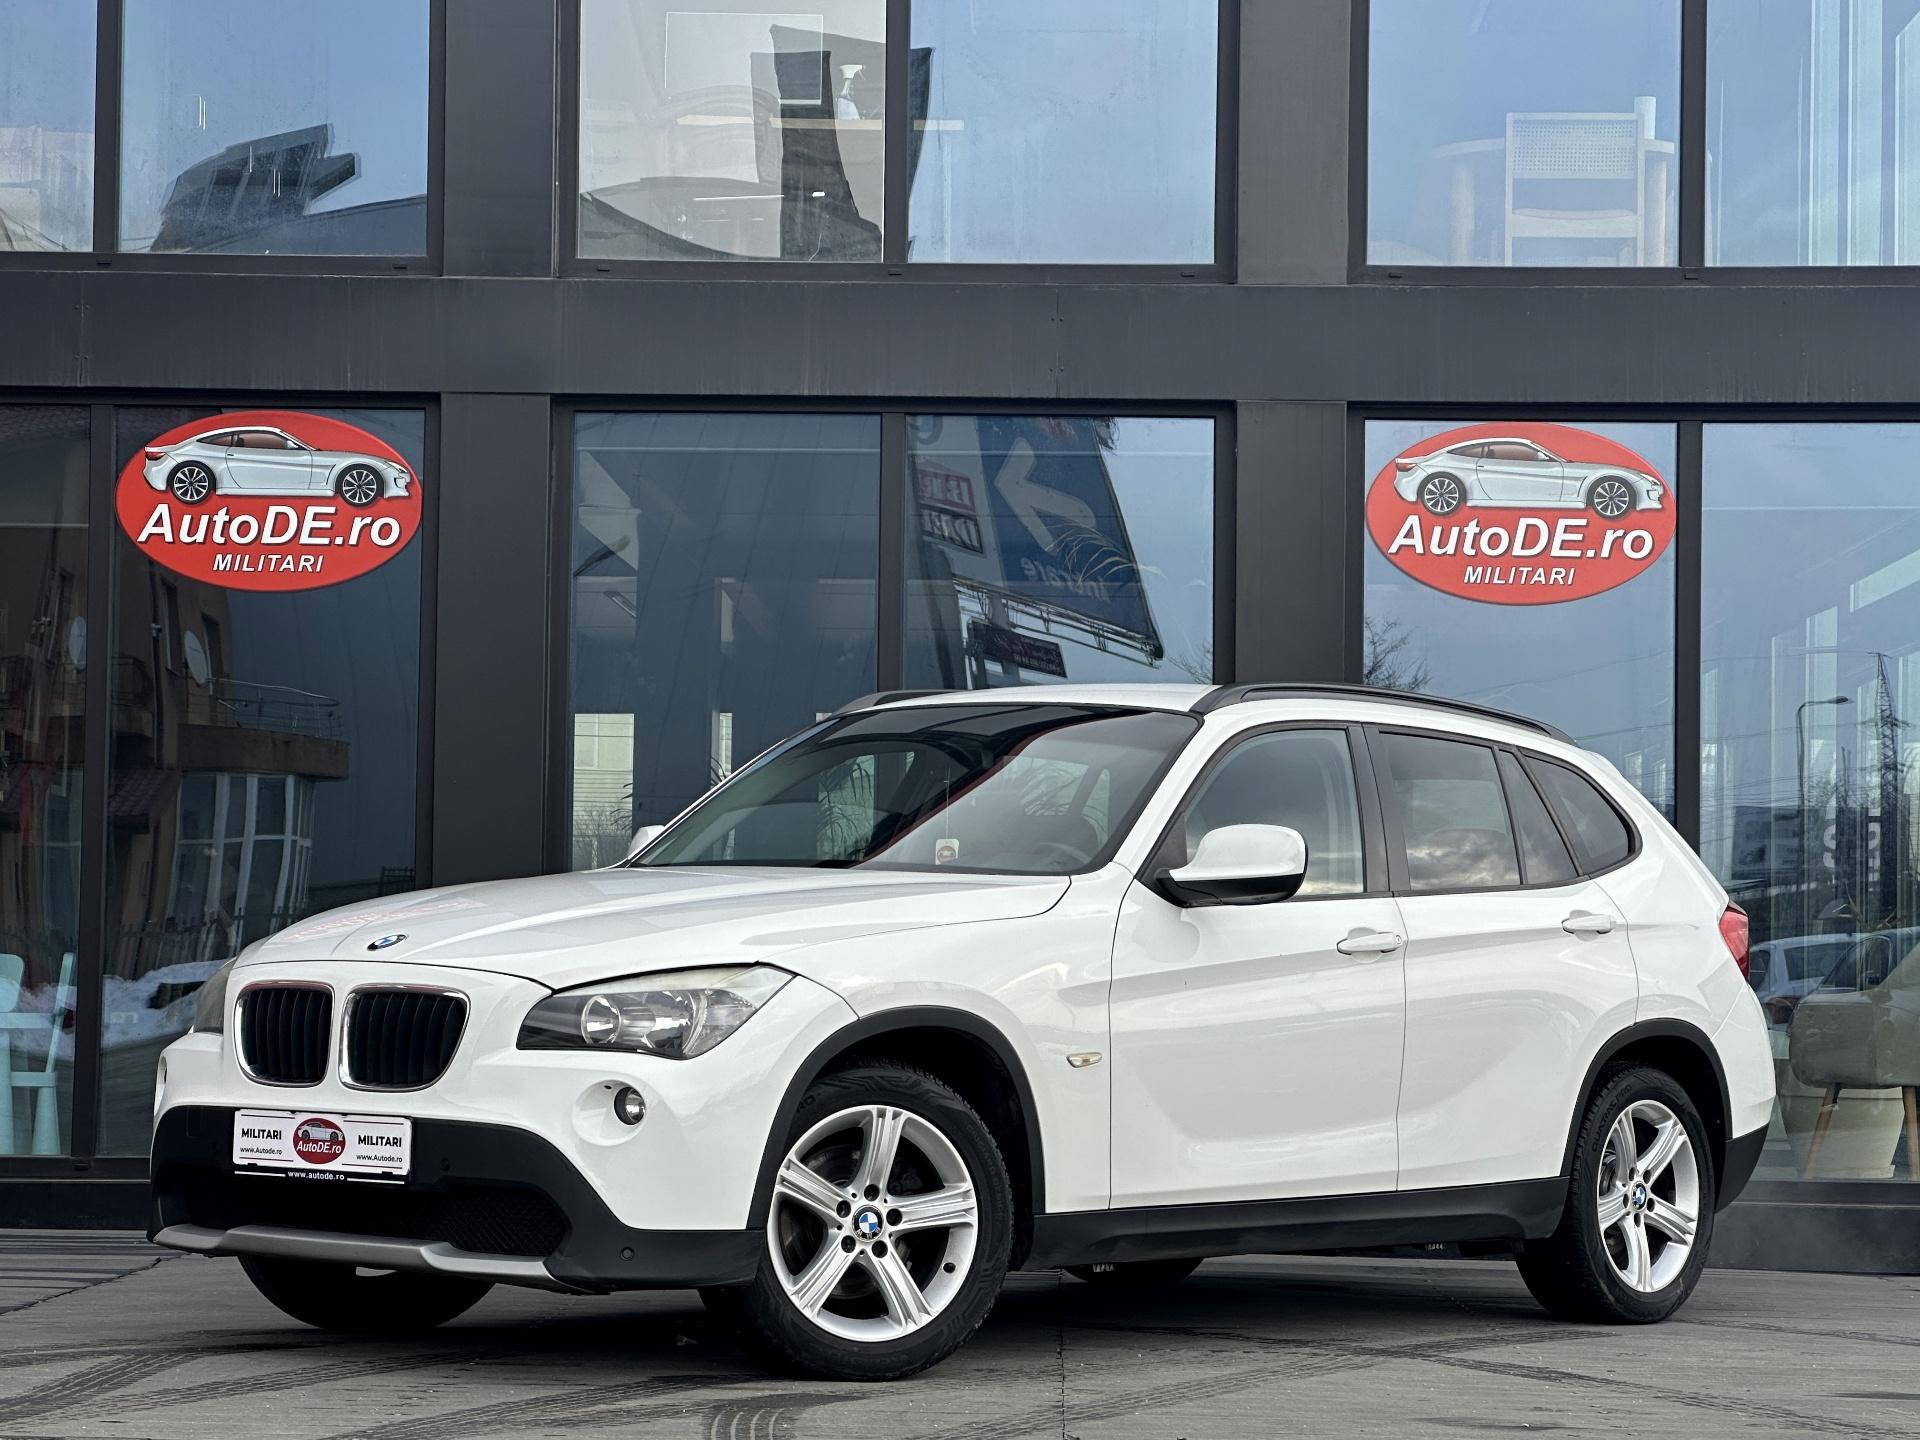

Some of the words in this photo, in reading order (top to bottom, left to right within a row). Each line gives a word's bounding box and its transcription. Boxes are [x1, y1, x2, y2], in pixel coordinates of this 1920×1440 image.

[137, 503, 401, 546] AutoDE.ro
[1387, 514, 1654, 560] AutoDE.ro
[212, 553, 324, 573] MILITARI
[1463, 566, 1576, 586] MILITARI
[241, 1128, 282, 1140] MILITARI
[296, 1140, 342, 1154] AutoDE.ro
[358, 1135, 402, 1148] MILITARI
[239, 1146, 283, 1156] www.Autode.ro
[356, 1153, 403, 1163] www.Autode.ro
[287, 1170, 345, 1181] www.autode.ro
